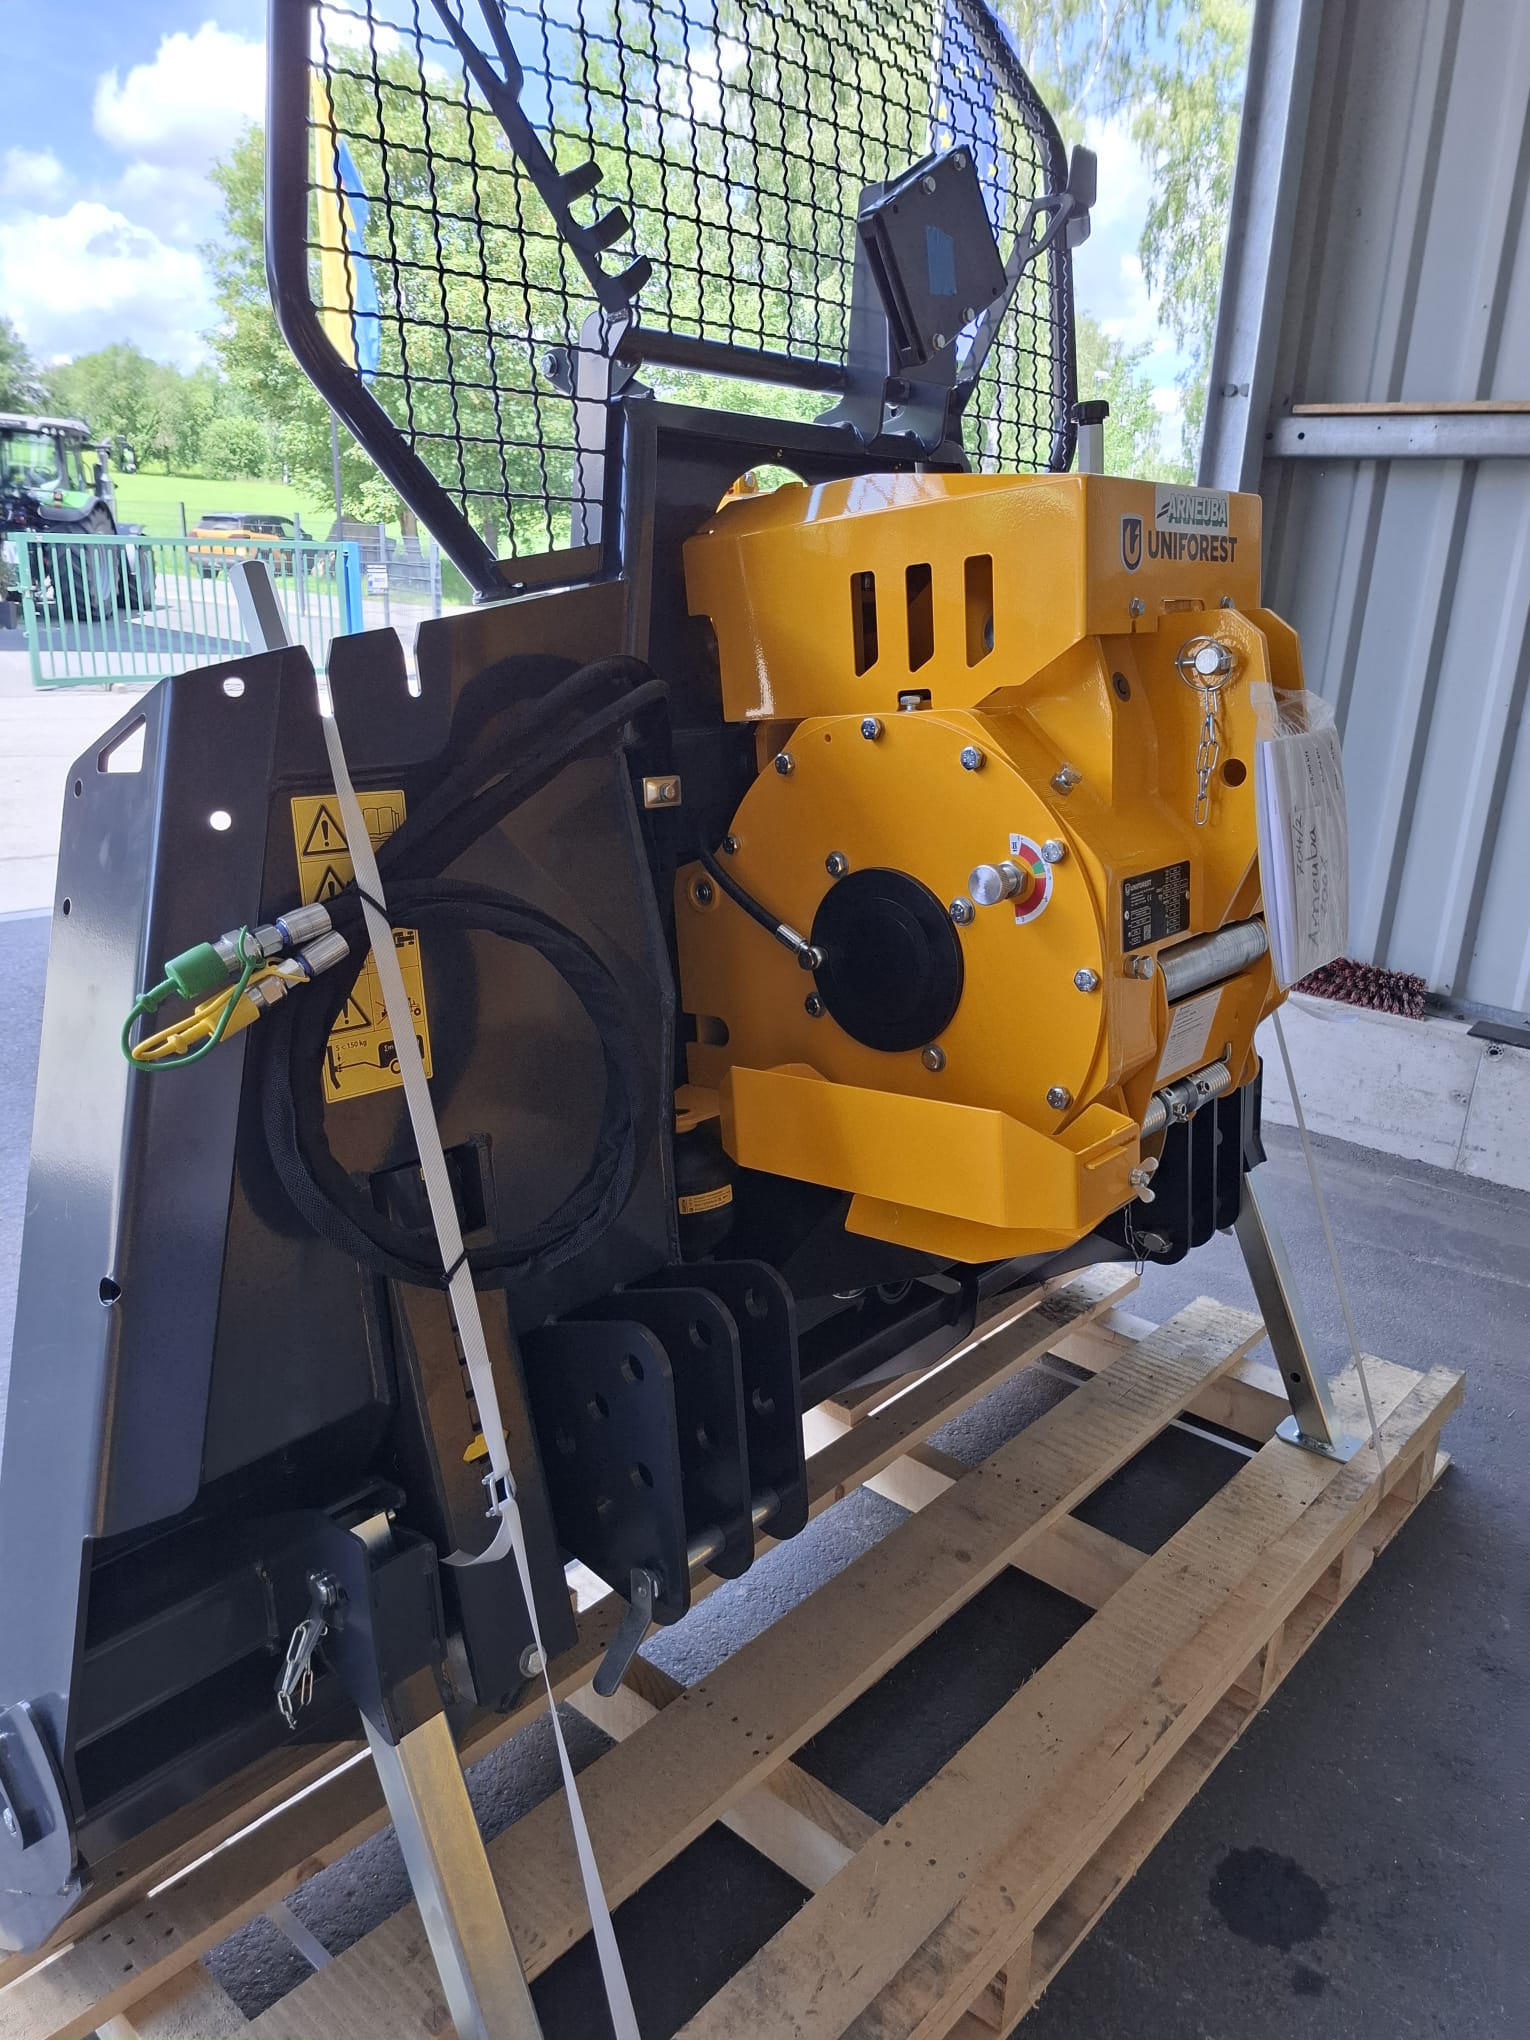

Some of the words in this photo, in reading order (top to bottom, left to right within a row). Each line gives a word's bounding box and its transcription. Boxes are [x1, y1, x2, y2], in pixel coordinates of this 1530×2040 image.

[1167, 493, 1228, 528] ARNEUBA
[1147, 529, 1238, 563] UNIFOREST
[1305, 825, 1320, 946] Arneuba
[347, 1041, 359, 1049] 150
[359, 1039, 368, 1048] kg
